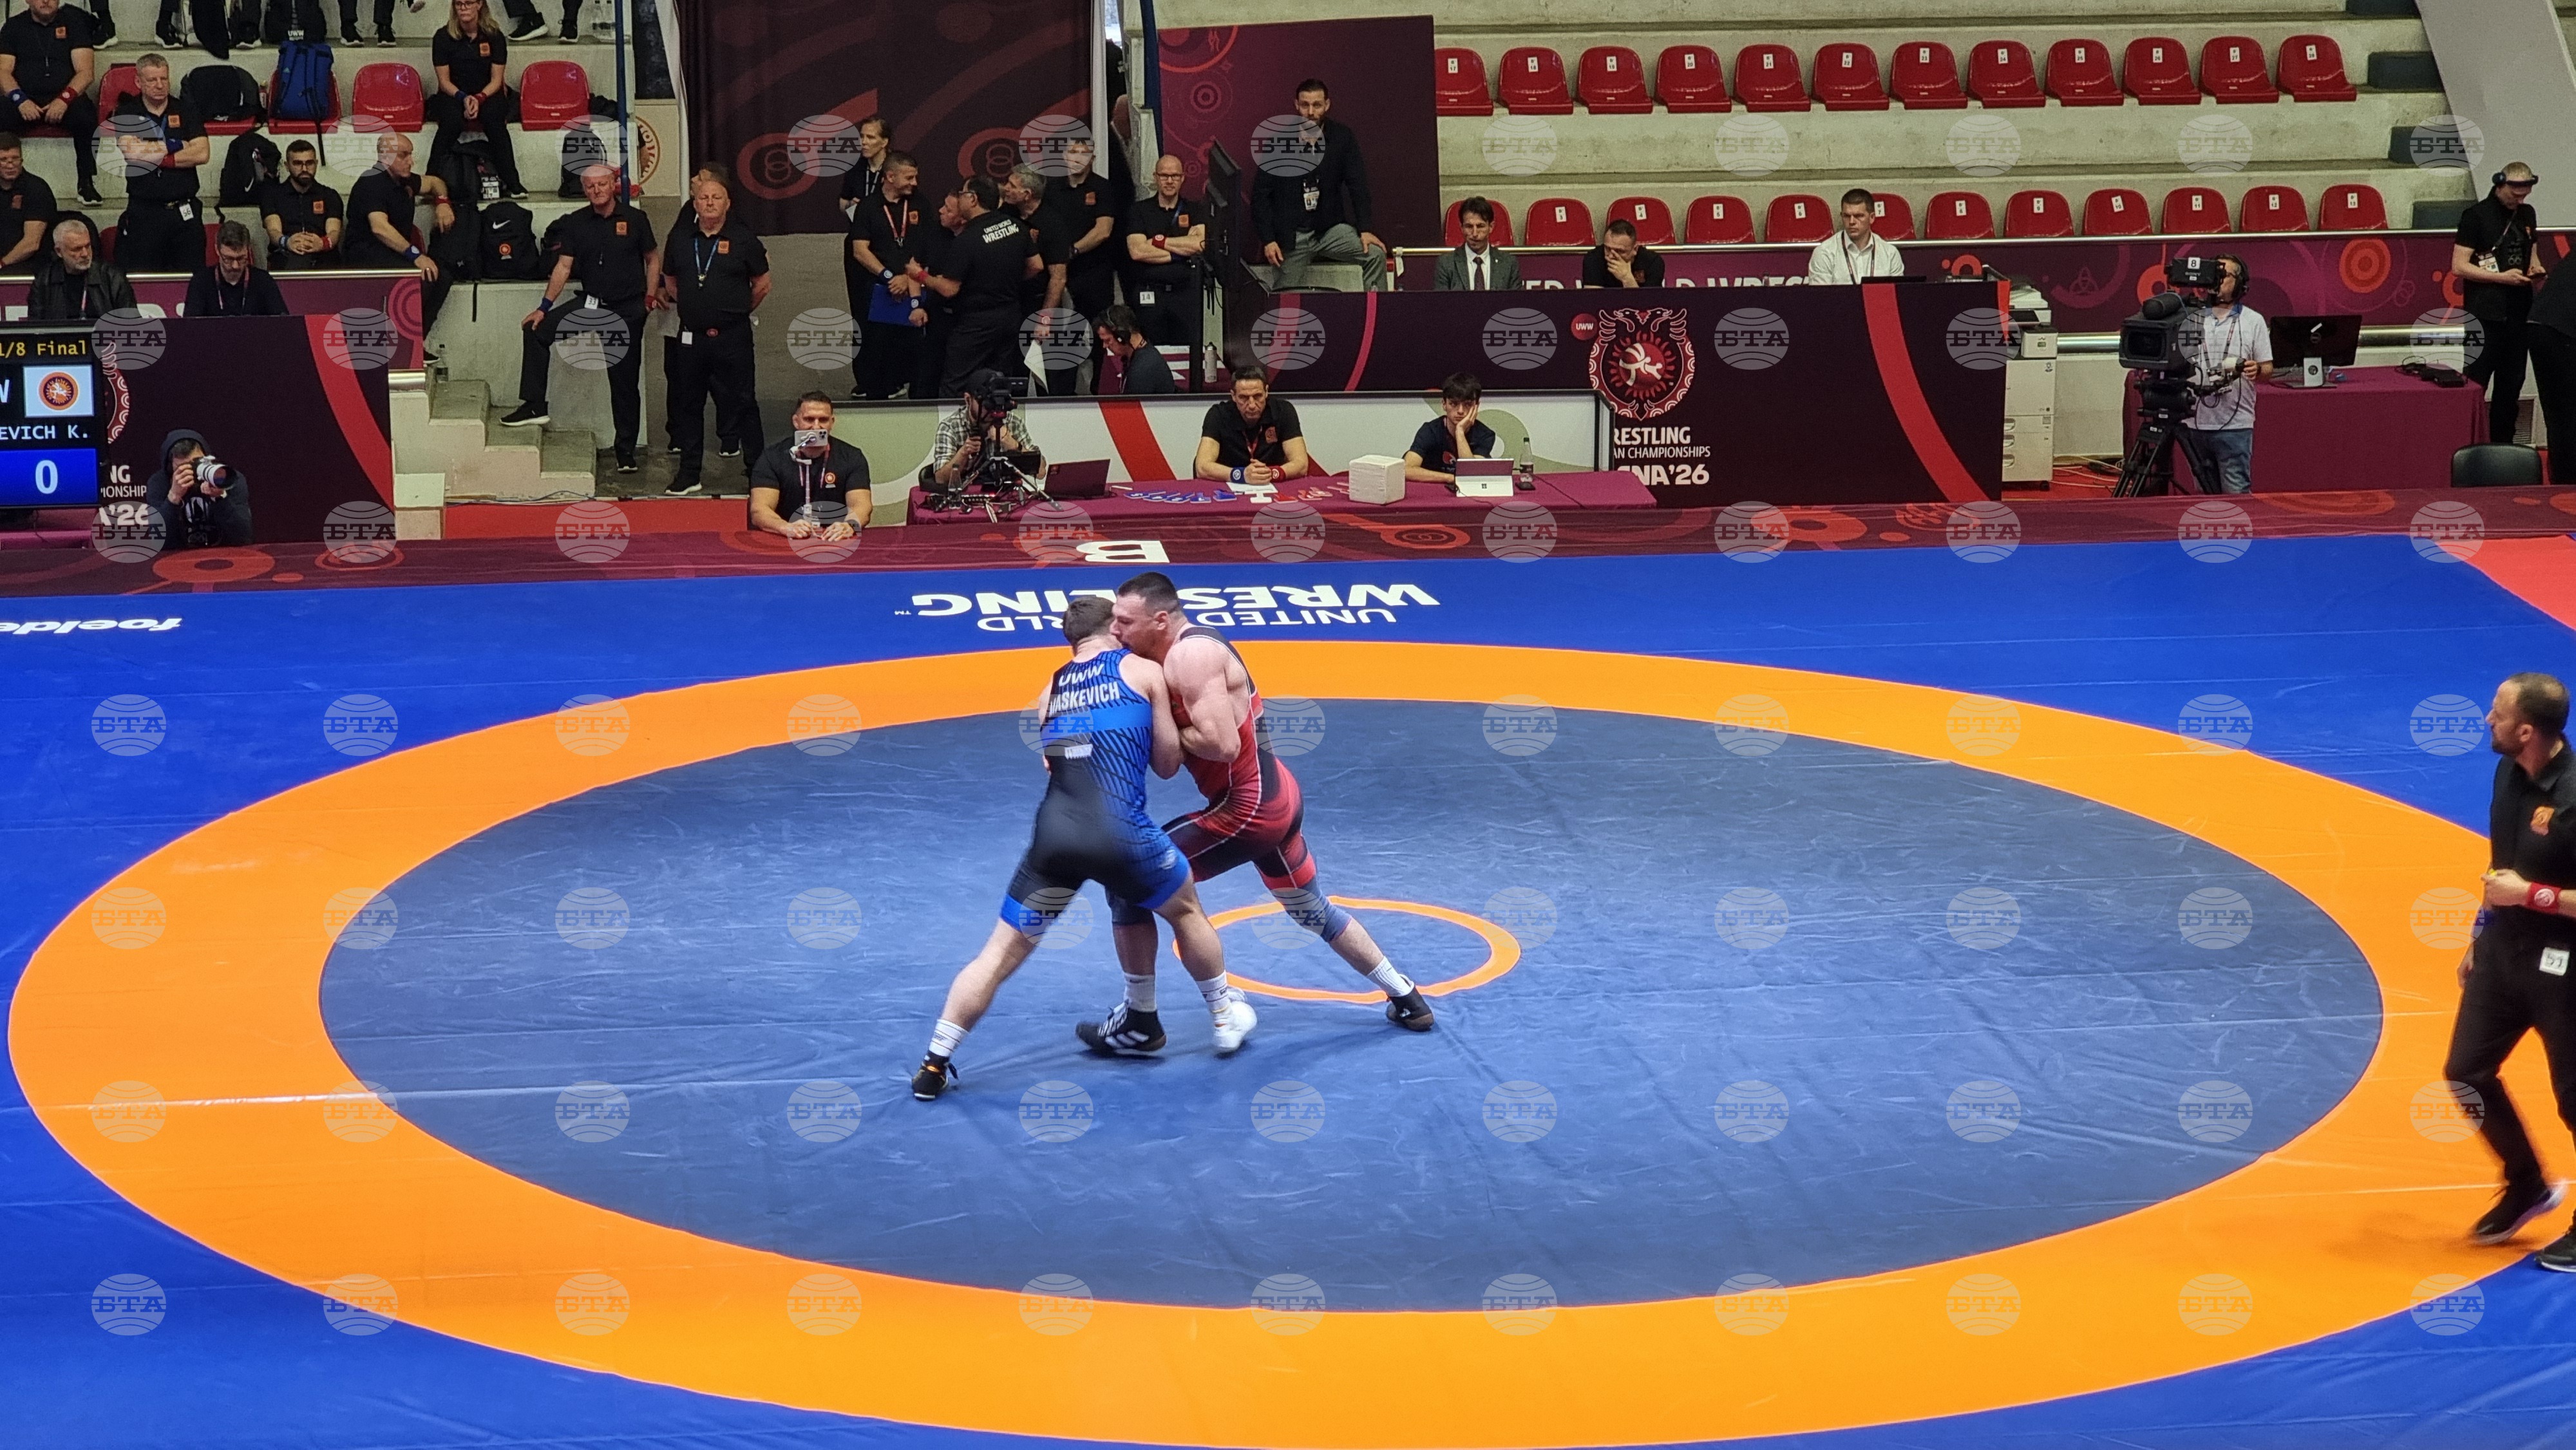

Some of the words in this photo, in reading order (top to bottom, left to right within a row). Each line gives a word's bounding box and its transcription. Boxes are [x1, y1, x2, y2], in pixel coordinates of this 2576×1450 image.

[982, 223, 1019, 243] WRESTLING
[983, 223, 999, 234] UNITED
[37, 340, 86, 355] Final
[68, 424, 88, 439] K.
[1613, 426, 1691, 446] RESTLING
[1627, 446, 1711, 459] CHAMPIONSHIPS
[35, 460, 58, 494] 0
[1617, 464, 1710, 485] NA'26
[100, 485, 147, 498] IONSHIP
[1075, 540, 1170, 563] B
[976, 616, 1064, 632] RLD
[1196, 608, 1397, 626] UNITED
[1058, 663, 1105, 687] UWW
